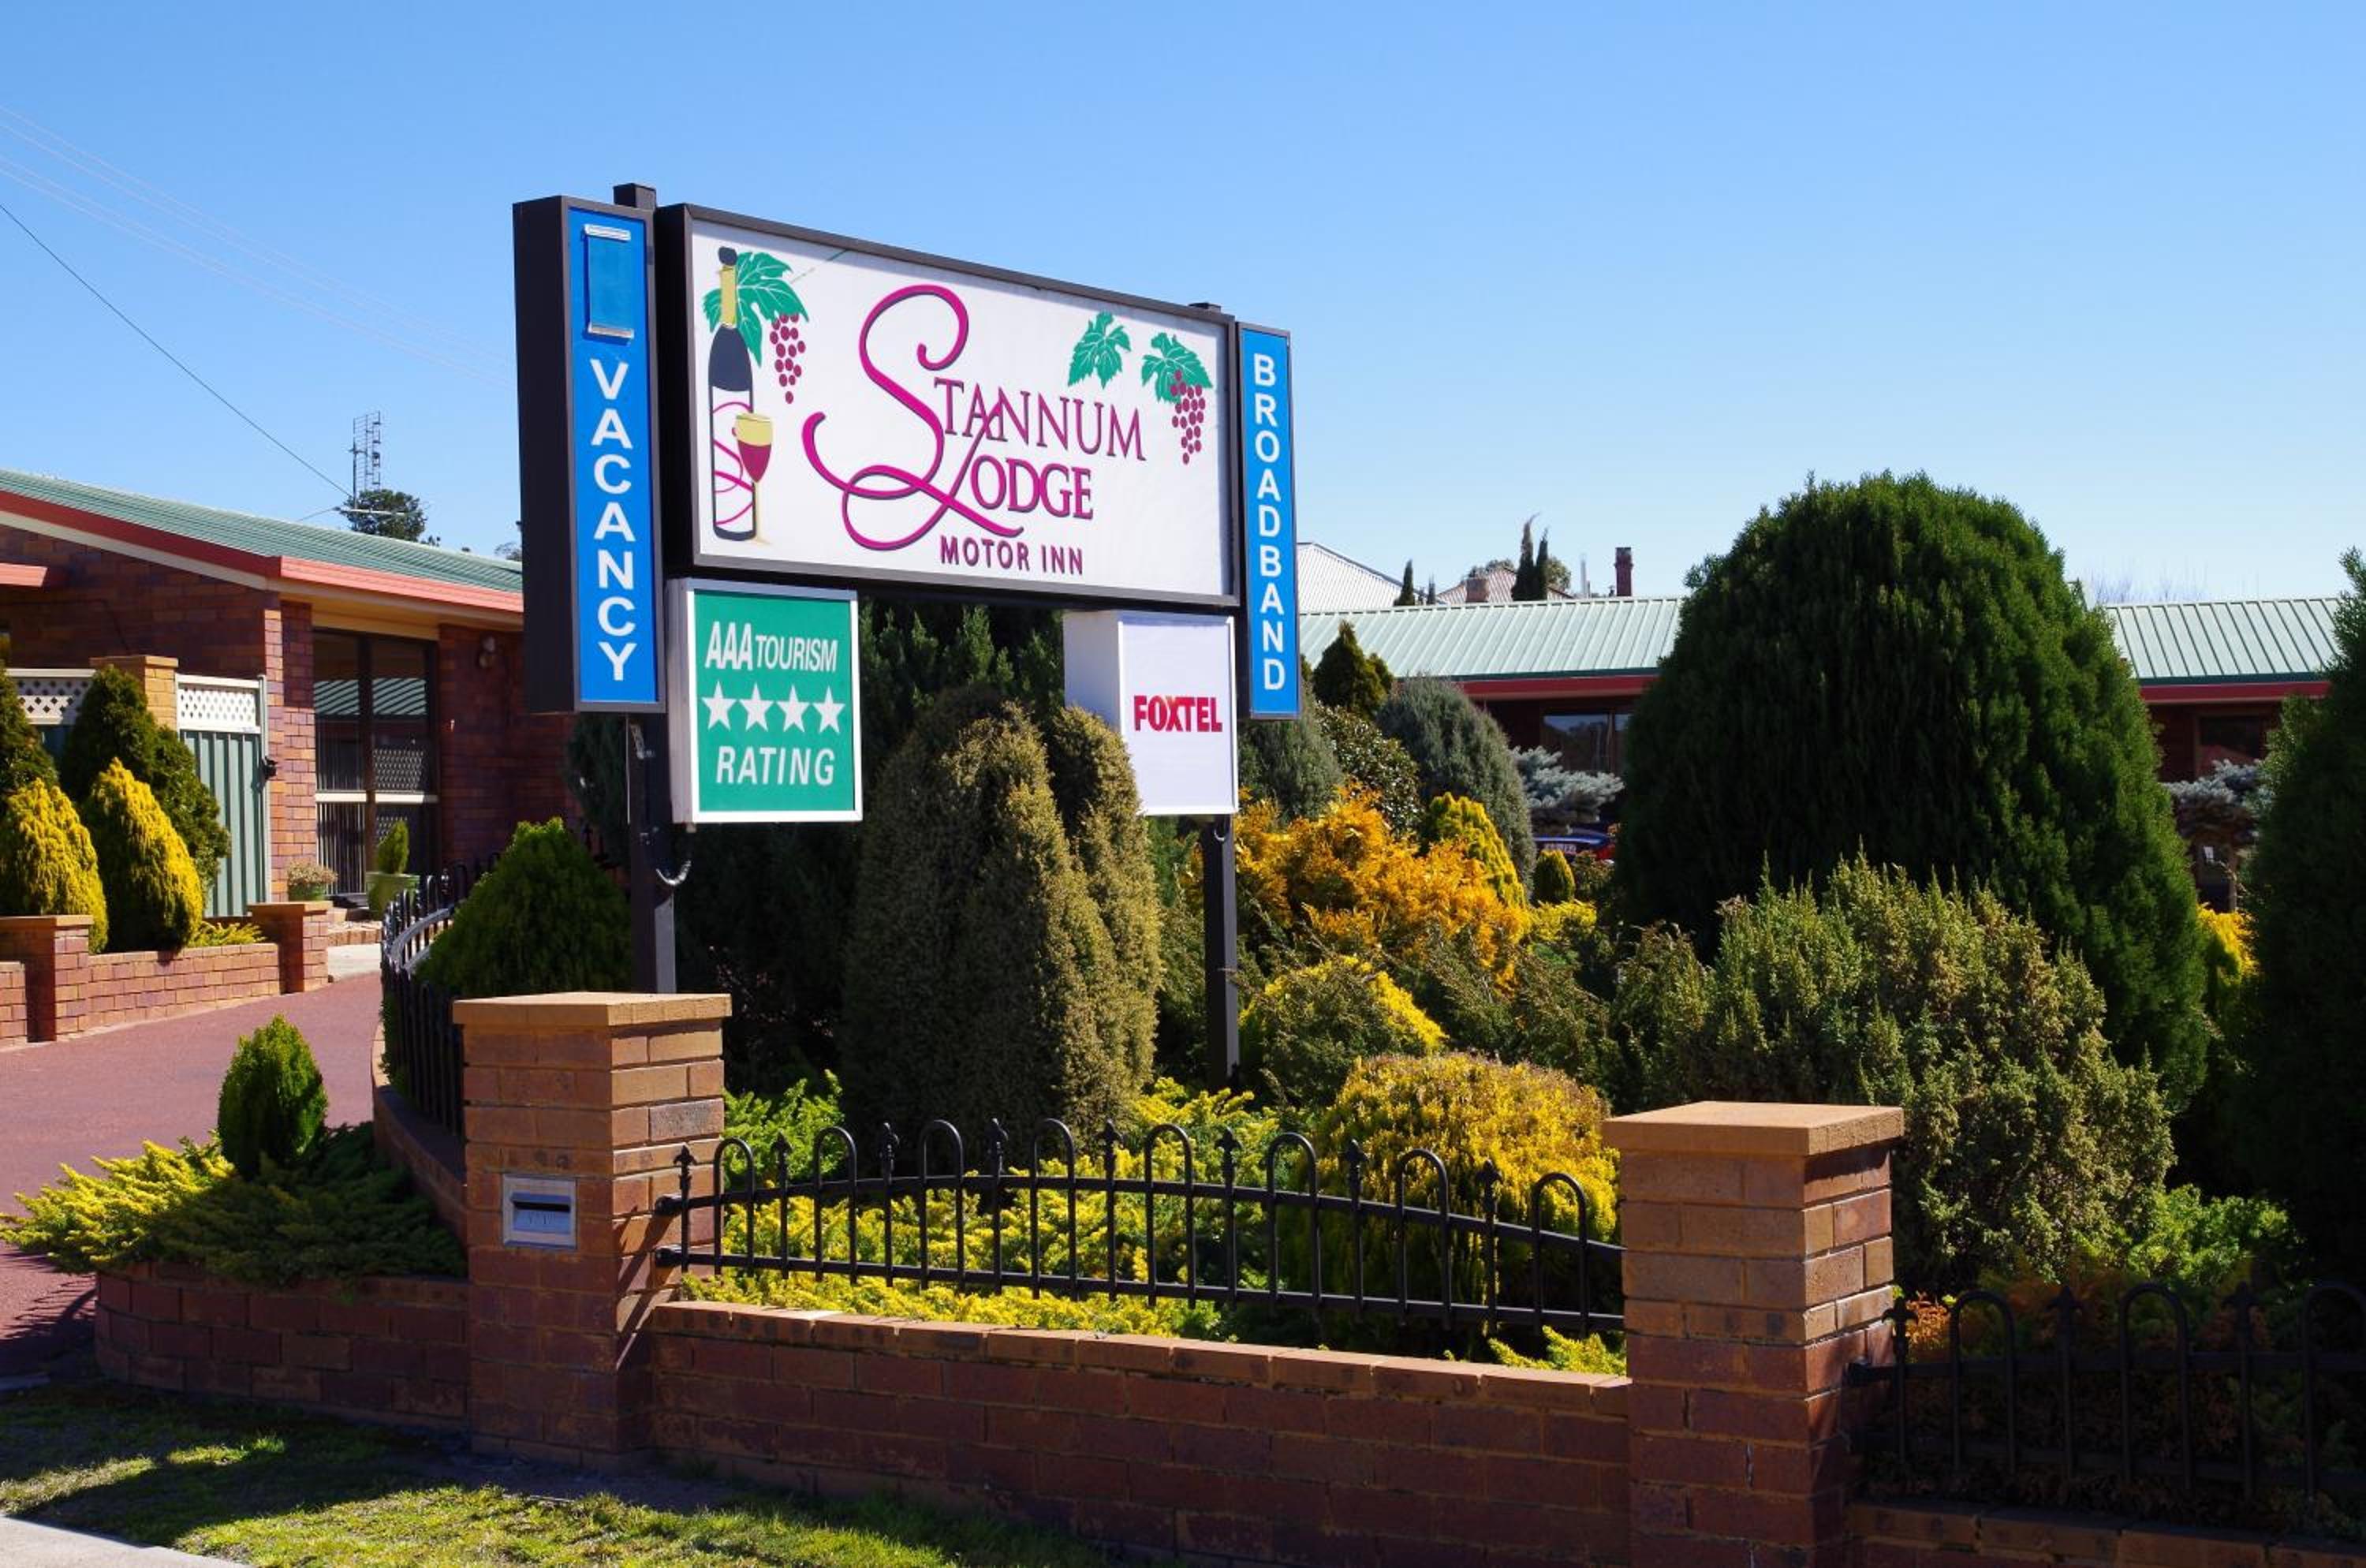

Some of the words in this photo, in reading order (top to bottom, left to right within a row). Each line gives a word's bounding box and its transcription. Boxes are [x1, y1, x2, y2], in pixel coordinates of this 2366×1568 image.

[801, 284, 1147, 500] STANNUM
[590, 358, 636, 681] VACANCY
[1252, 353, 1286, 690] BROADBAND
[939, 535, 1030, 572] MOTOR
[1040, 543, 1084, 576] INN
[704, 621, 753, 670] AAA
[755, 634, 838, 674] TOURISM
[1133, 695, 1223, 733] FOXTEL
[715, 745, 836, 786] RATING
